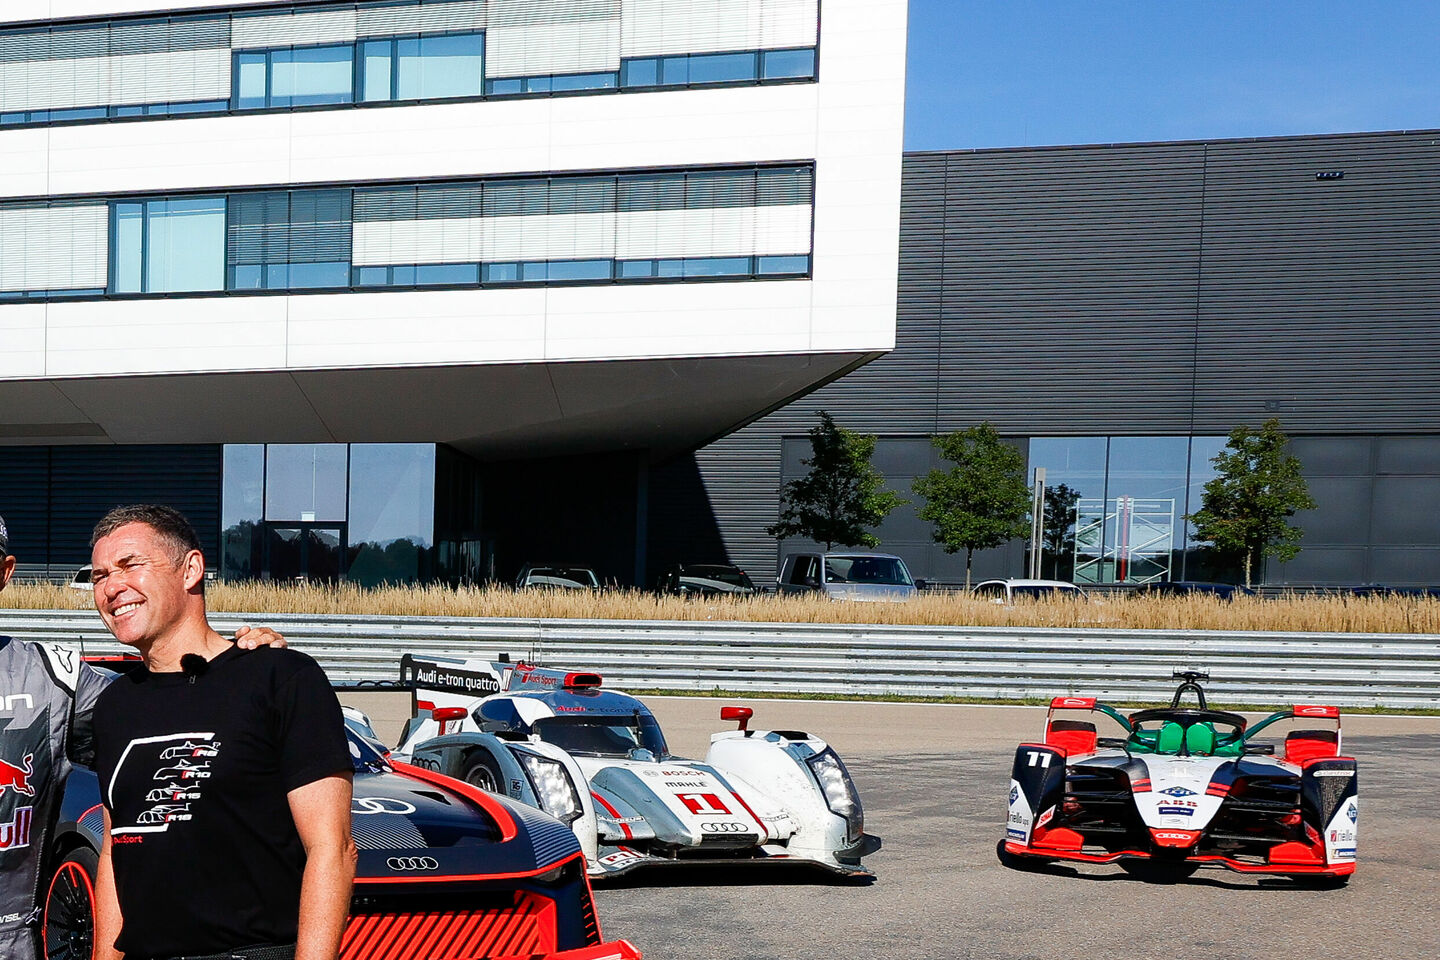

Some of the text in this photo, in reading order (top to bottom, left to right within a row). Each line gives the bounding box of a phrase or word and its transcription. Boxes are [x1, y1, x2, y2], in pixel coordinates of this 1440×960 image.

[416, 668, 500, 692] Audi e-tron quattro
[541, 675, 558, 686] Sport
[555, 704, 587, 713] Audi
[1026, 751, 1052, 769] 11
[175, 792, 201, 800] R15
[683, 794, 727, 815] 1
[605, 852, 629, 862] P1
